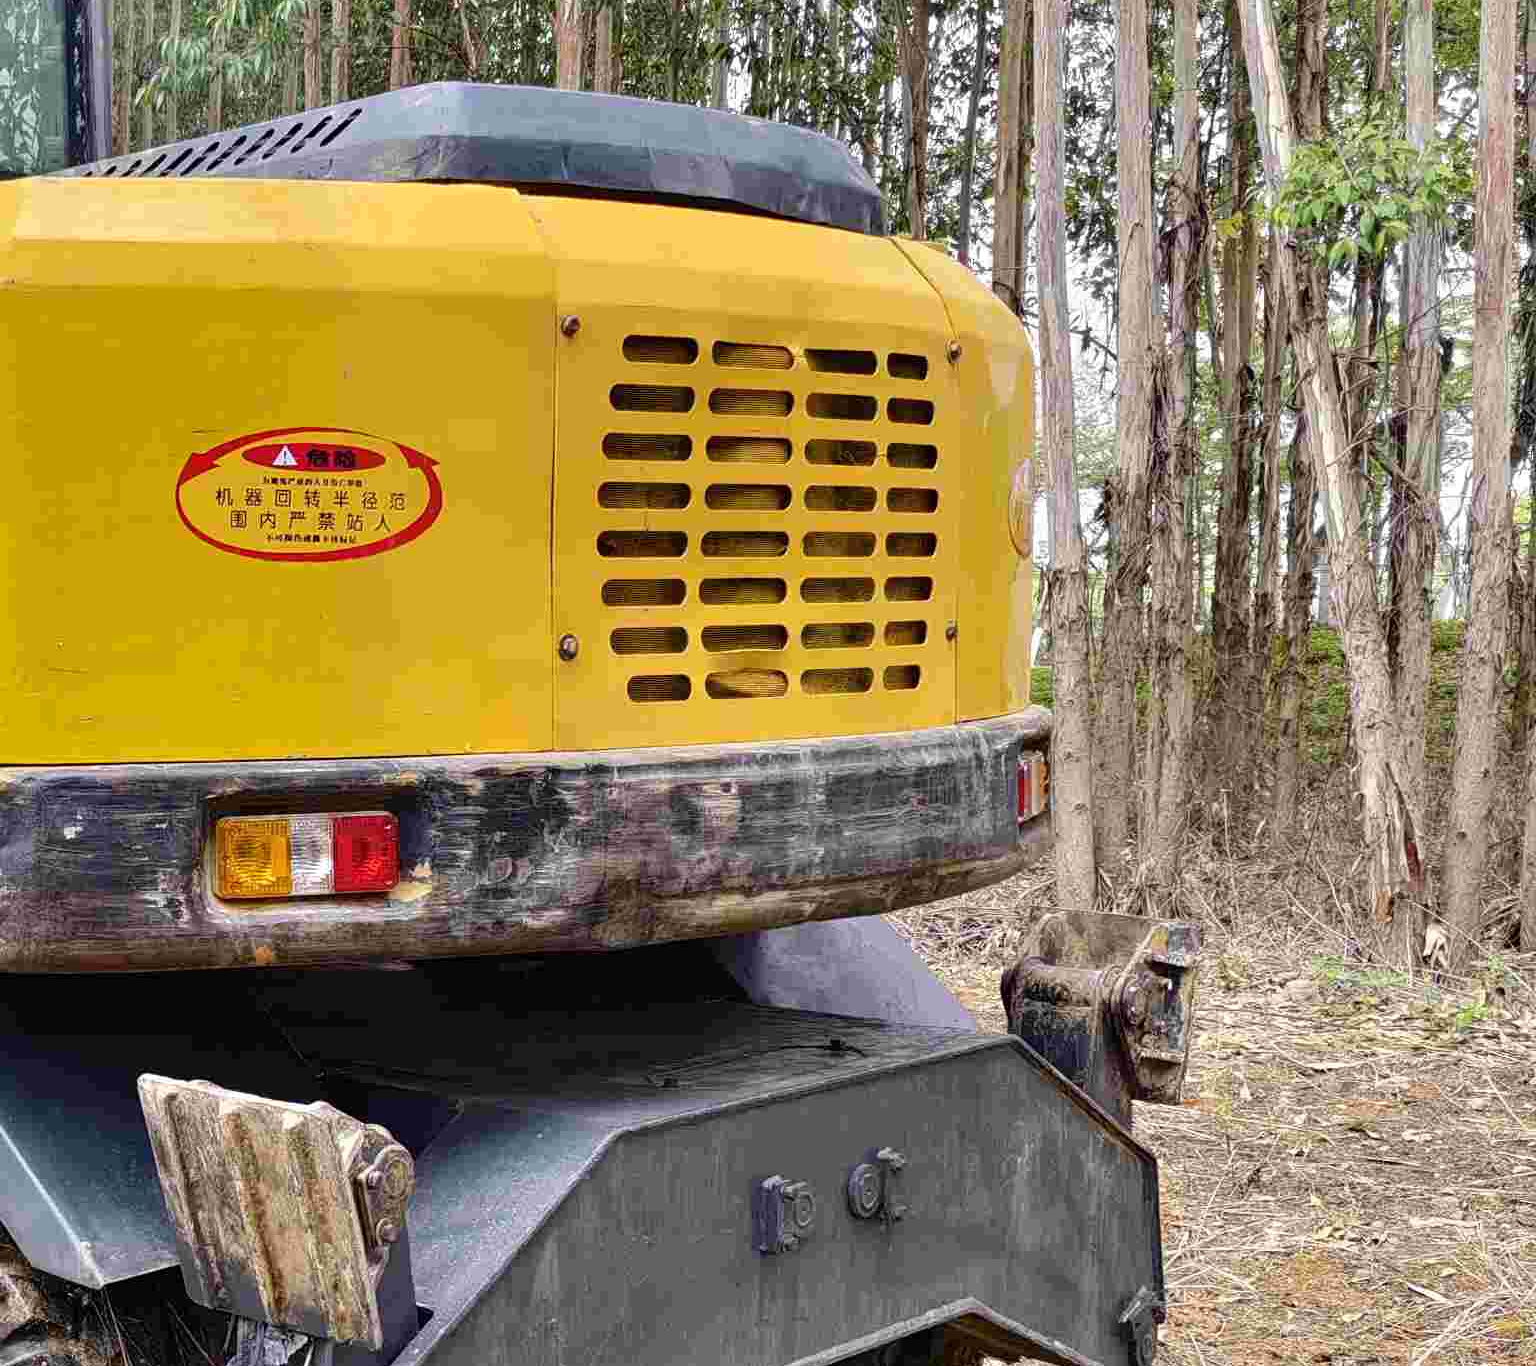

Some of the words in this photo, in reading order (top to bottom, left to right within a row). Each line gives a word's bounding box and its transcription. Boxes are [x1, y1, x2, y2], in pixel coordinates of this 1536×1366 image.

[215, 488, 409, 511] 机器回转半径范
[230, 510, 392, 533] 围内严禁站人
